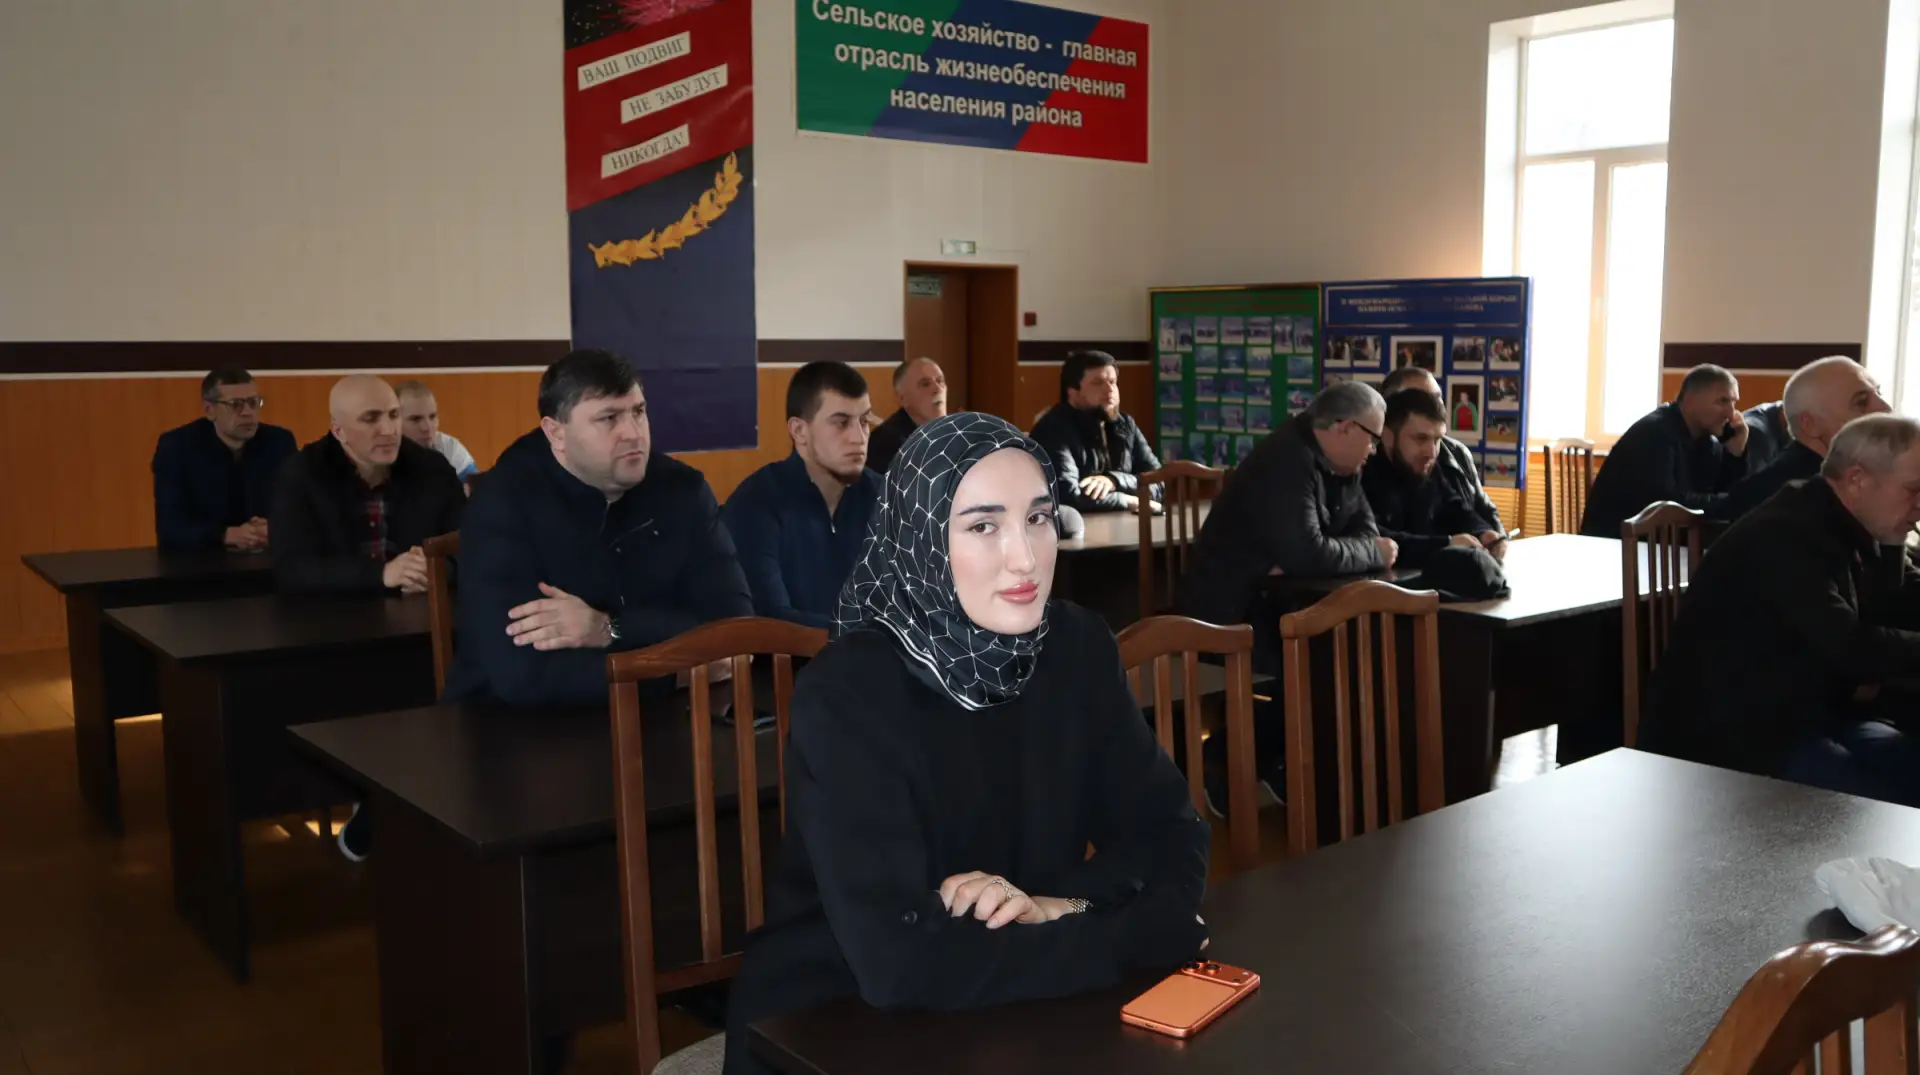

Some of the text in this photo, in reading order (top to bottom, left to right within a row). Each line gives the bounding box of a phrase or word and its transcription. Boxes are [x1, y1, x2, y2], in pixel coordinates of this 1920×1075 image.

[812, 0, 925, 35] Сельское
[931, 21, 1040, 52] хозяйство
[1062, 40, 1137, 67] главная
[582, 37, 685, 84] ВАШ ПОДВИГ
[834, 43, 1126, 99] отрасль жизнеобеспечения
[629, 72, 720, 116] НЕ ЗАБУДУТ
[890, 88, 1083, 127] населения района
[611, 132, 684, 170] НИКОГДА!
